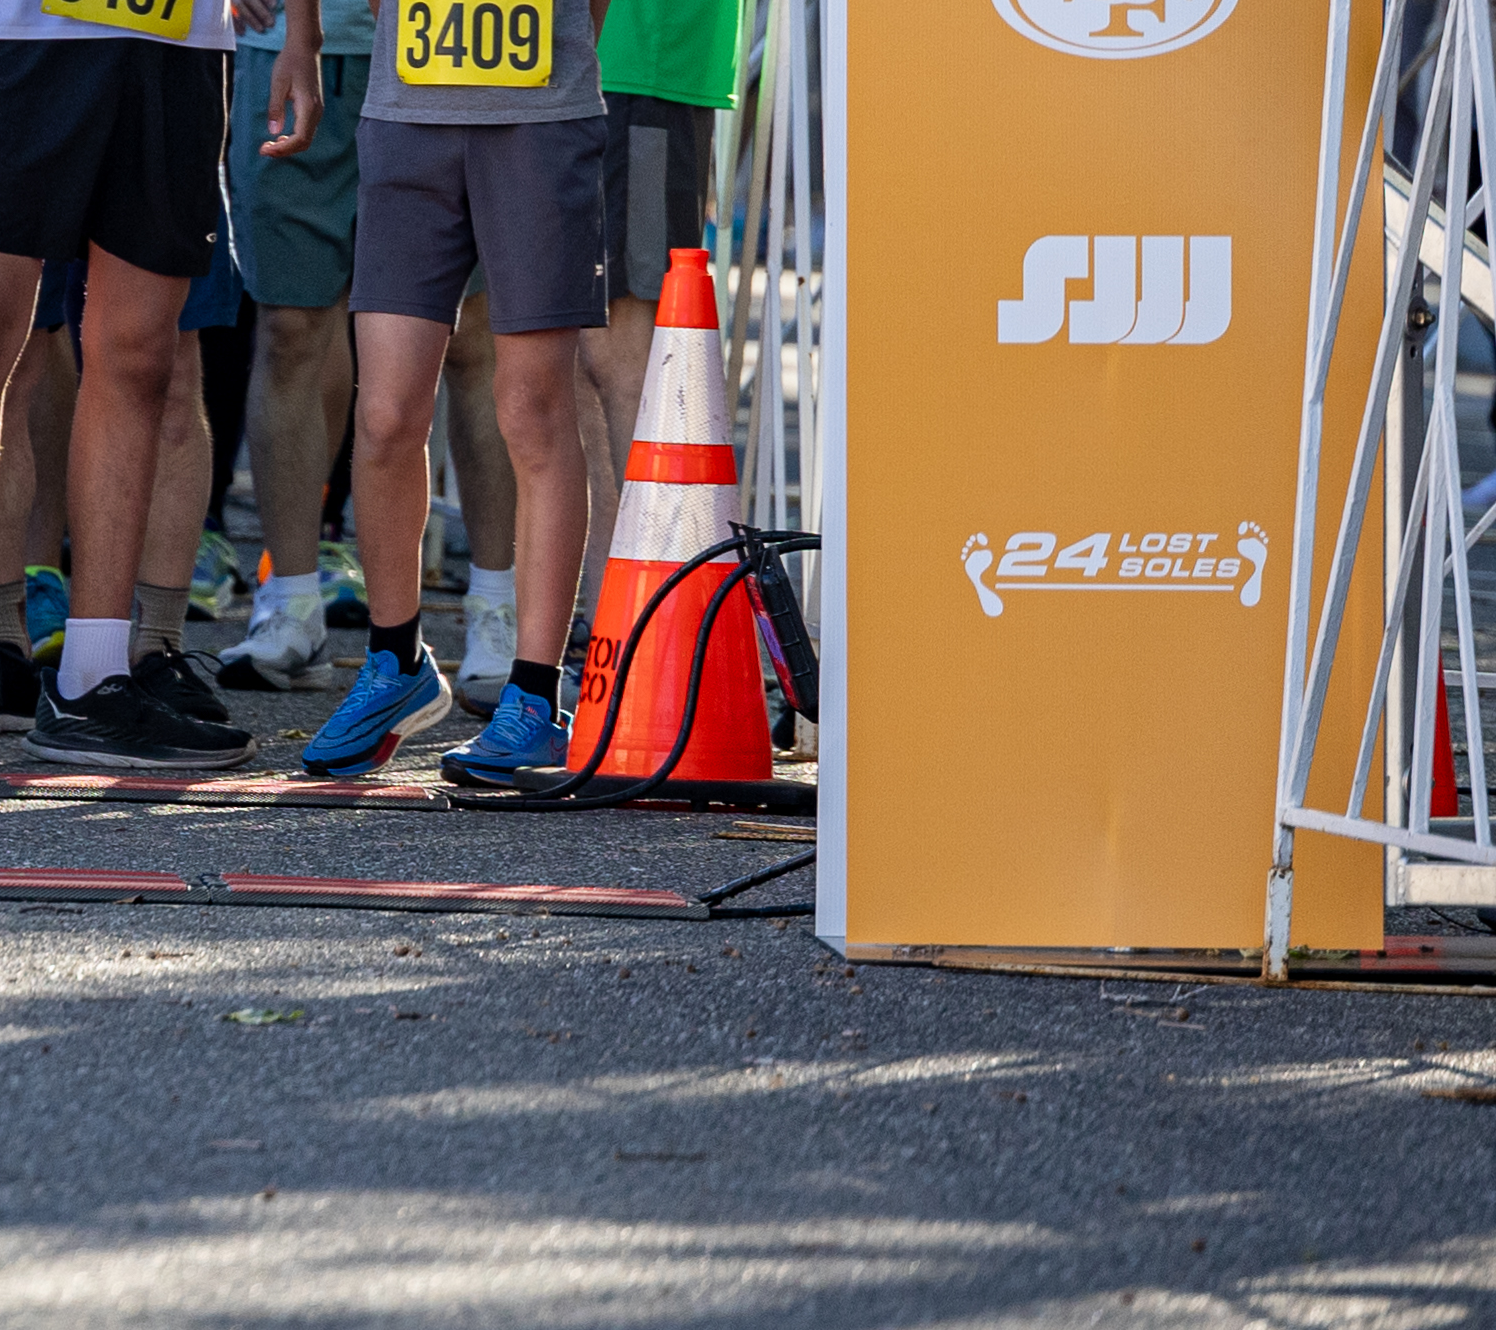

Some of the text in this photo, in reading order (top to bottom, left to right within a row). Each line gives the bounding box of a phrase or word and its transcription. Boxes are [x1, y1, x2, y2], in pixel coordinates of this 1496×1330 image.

[406, 2, 540, 71] 3409
[996, 532, 1219, 578] 24 LOST
[1118, 557, 1241, 578] SOLES
